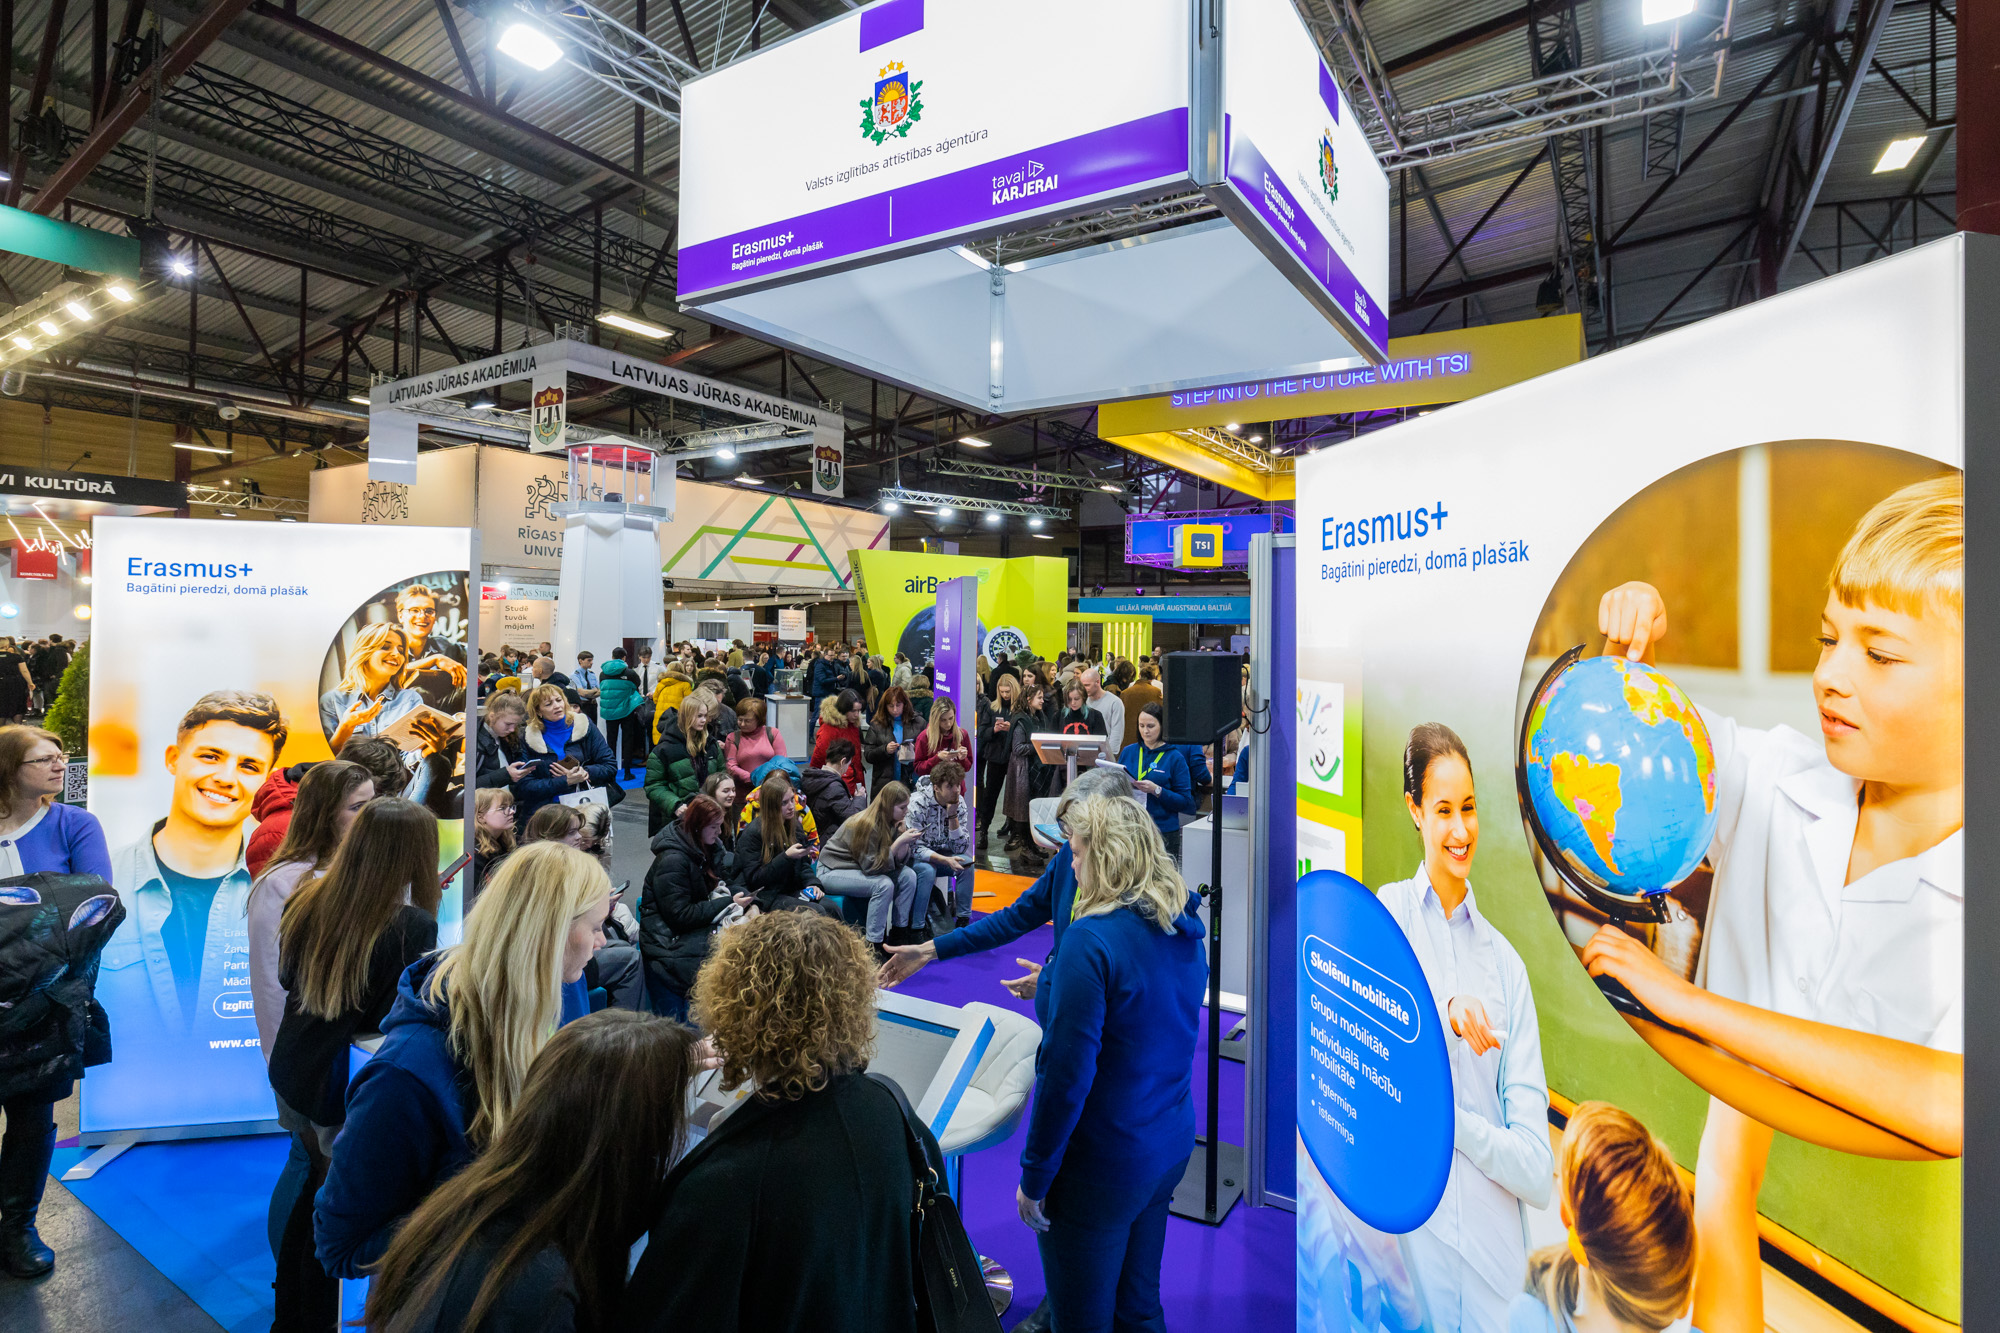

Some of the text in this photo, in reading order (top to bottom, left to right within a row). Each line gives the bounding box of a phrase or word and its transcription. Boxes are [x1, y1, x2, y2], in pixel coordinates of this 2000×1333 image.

[806, 128, 988, 192] Valsts izglītības attīstības aģentūra
[992, 166, 1025, 189] tavai
[992, 174, 1058, 206] KARJERAI
[732, 231, 794, 259] Erasmus+
[732, 240, 824, 271] Bagātini pieredzi, domā plašāk
[389, 355, 537, 404] LATVIJAS JŪRAS AKADĒMIJA
[1302, 368, 1376, 391] FUTURE
[1380, 358, 1432, 381] WITH
[1436, 354, 1468, 375] TSI
[612, 360, 818, 428] LATVIJAS JŪRAS AKADĒMIJA
[25, 476, 116, 494] KULTŪRĀ
[518, 526, 557, 542] RĪGAS
[1195, 540, 1210, 550] TSI
[1322, 501, 1448, 552] Erasmus+
[128, 556, 253, 578] Erasmus+
[1321, 540, 1530, 583] Bagātini pieredzi, domā plašāk
[126, 582, 309, 597] Bagātini pieredzi, domā plašāk
[1116, 604, 1140, 612] LIELĀKĀ
[1141, 603, 1166, 612] PRIVĀTĀ
[1166, 604, 1207, 612] AUGSTSKOLA
[1310, 950, 1410, 1026] Skolēnu mobilitāte
[1310, 994, 1390, 1062] Grupu mobilitāte
[1310, 1021, 1402, 1104] Individuālā mācību
[1310, 1045, 1356, 1090] mobilitāte
[1318, 1076, 1357, 1120] ilgtermiņa
[1318, 1102, 1355, 1146] īstermiņa
